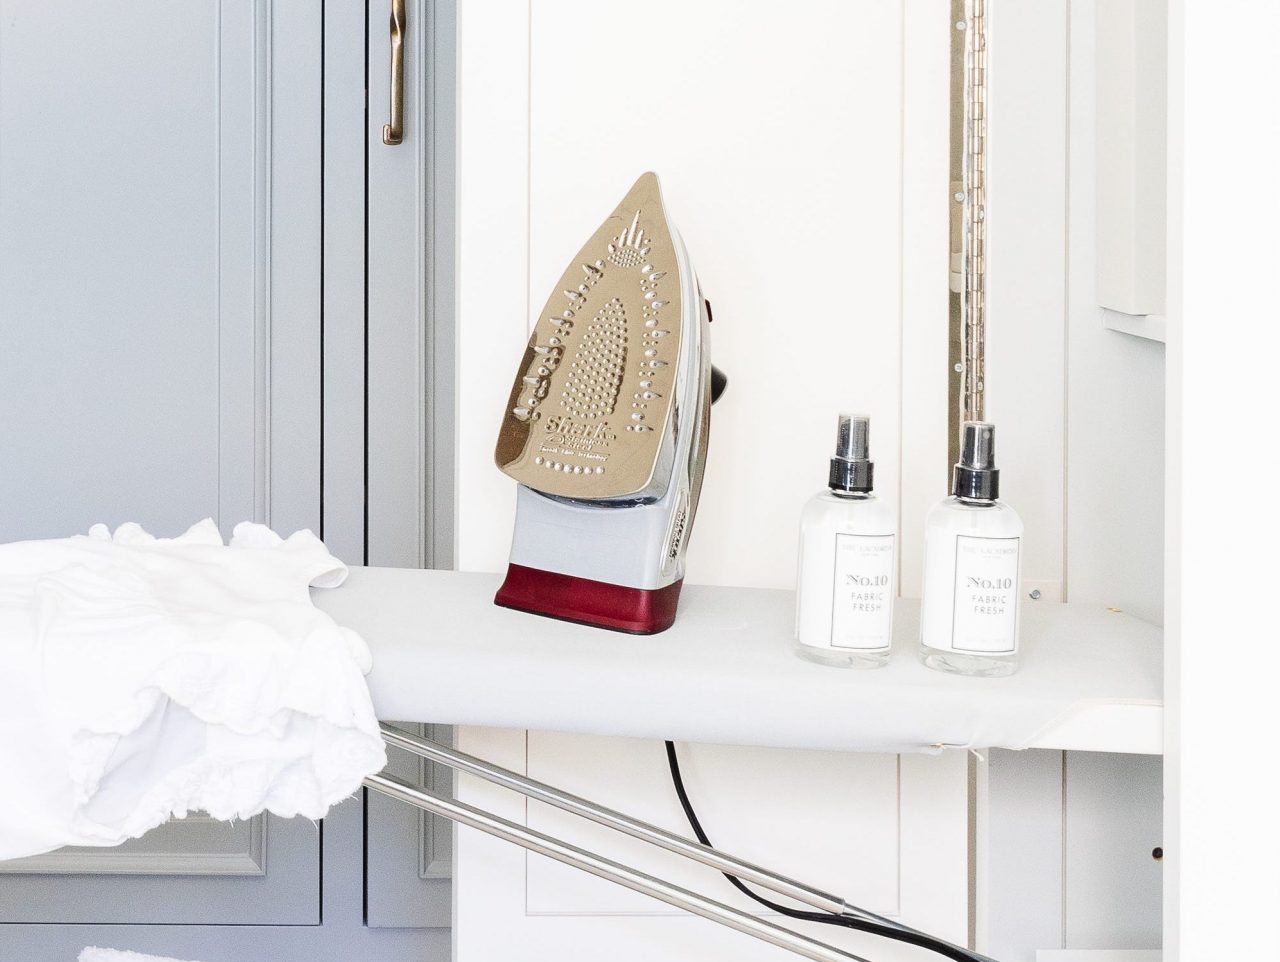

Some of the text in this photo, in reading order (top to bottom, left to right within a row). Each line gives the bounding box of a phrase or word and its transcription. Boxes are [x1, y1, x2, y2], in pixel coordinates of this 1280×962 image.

[846, 574, 889, 587] No.10
[967, 576, 1013, 590] No.10
[851, 592, 884, 601] FABRIC
[972, 595, 1007, 605] FABRIC
[853, 603, 882, 613] FRESH
[974, 606, 1005, 616] FRESH
